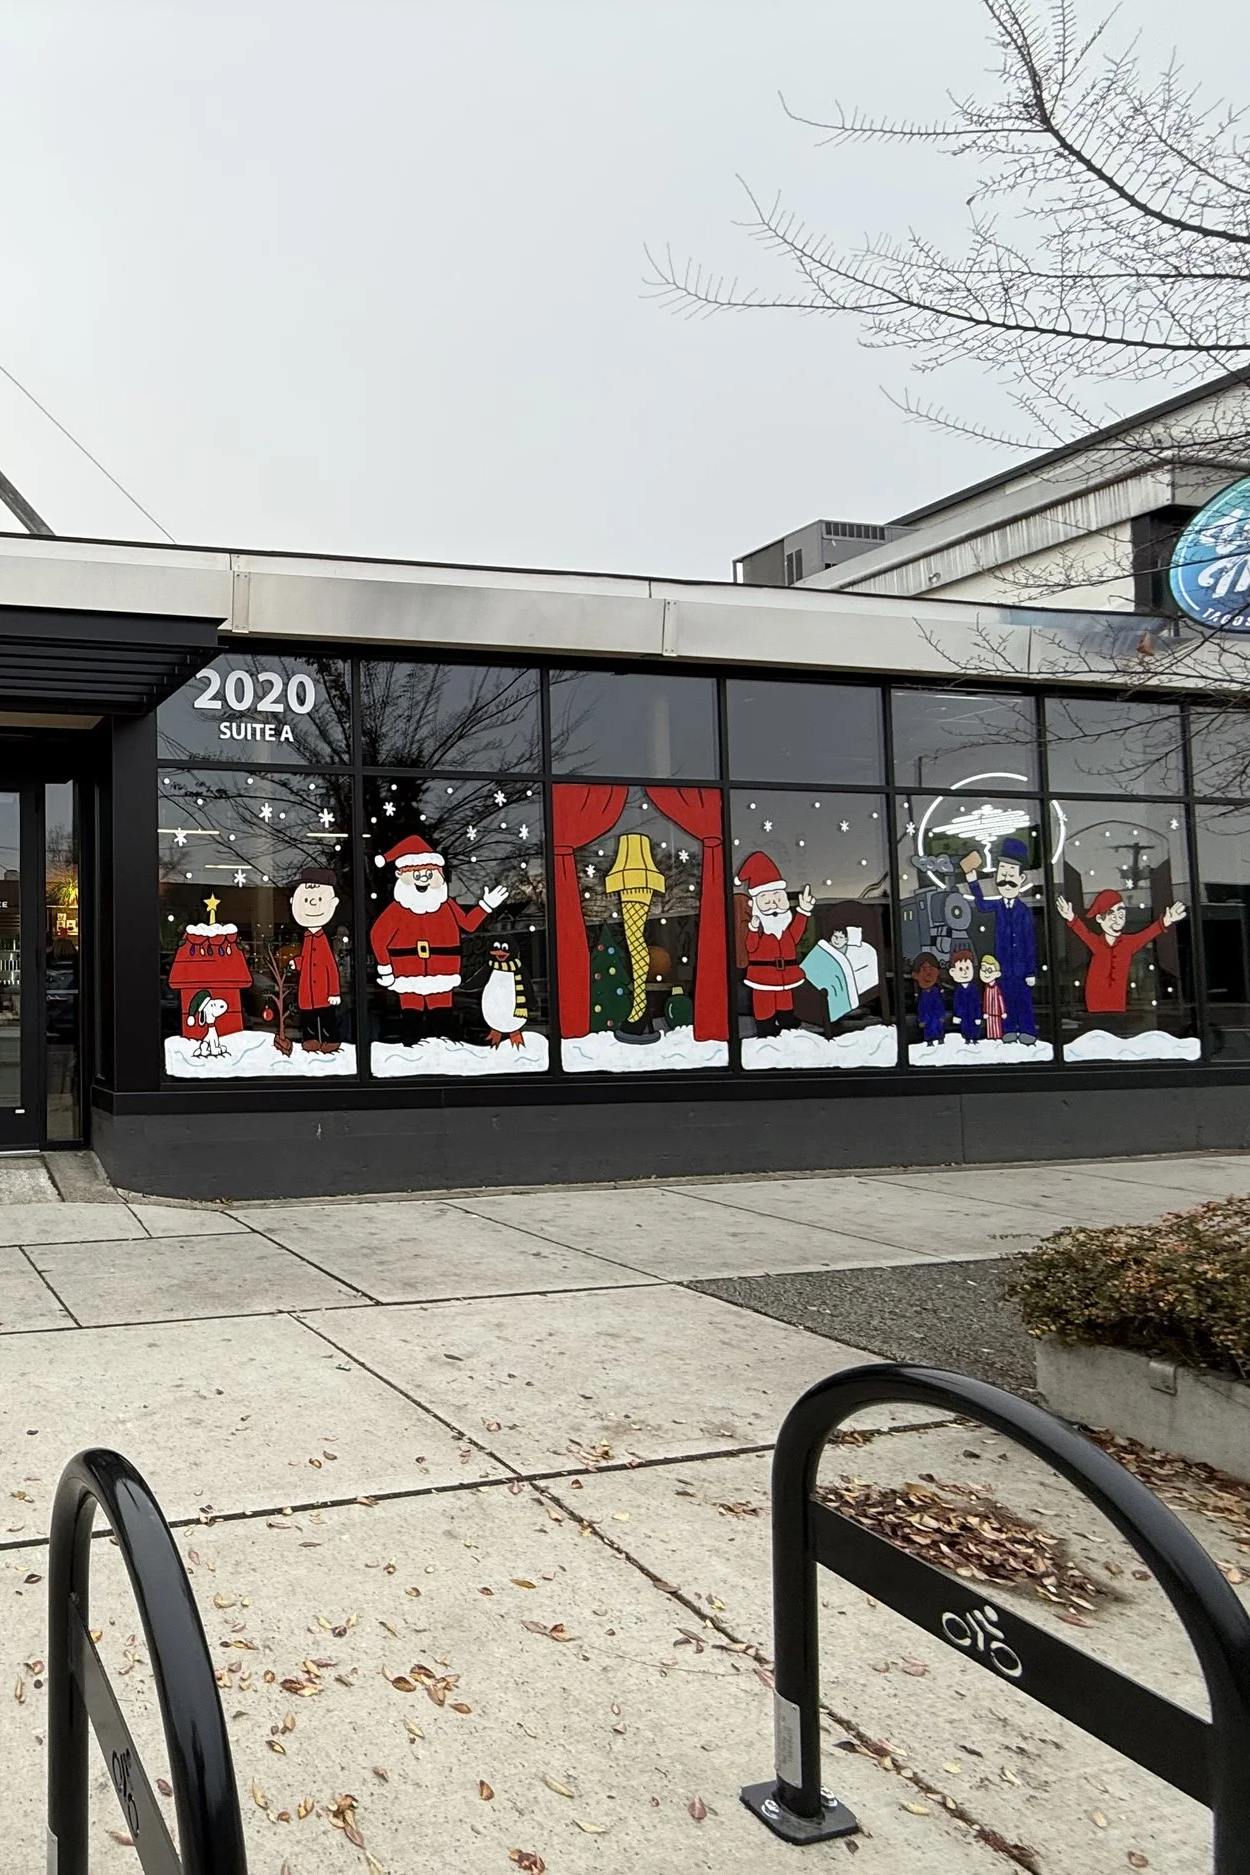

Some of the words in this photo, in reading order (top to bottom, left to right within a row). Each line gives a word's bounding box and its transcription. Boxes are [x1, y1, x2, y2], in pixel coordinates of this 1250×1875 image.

[193, 668, 316, 714] 2020
[219, 722, 276, 741] SUITE
[280, 724, 294, 742] A
